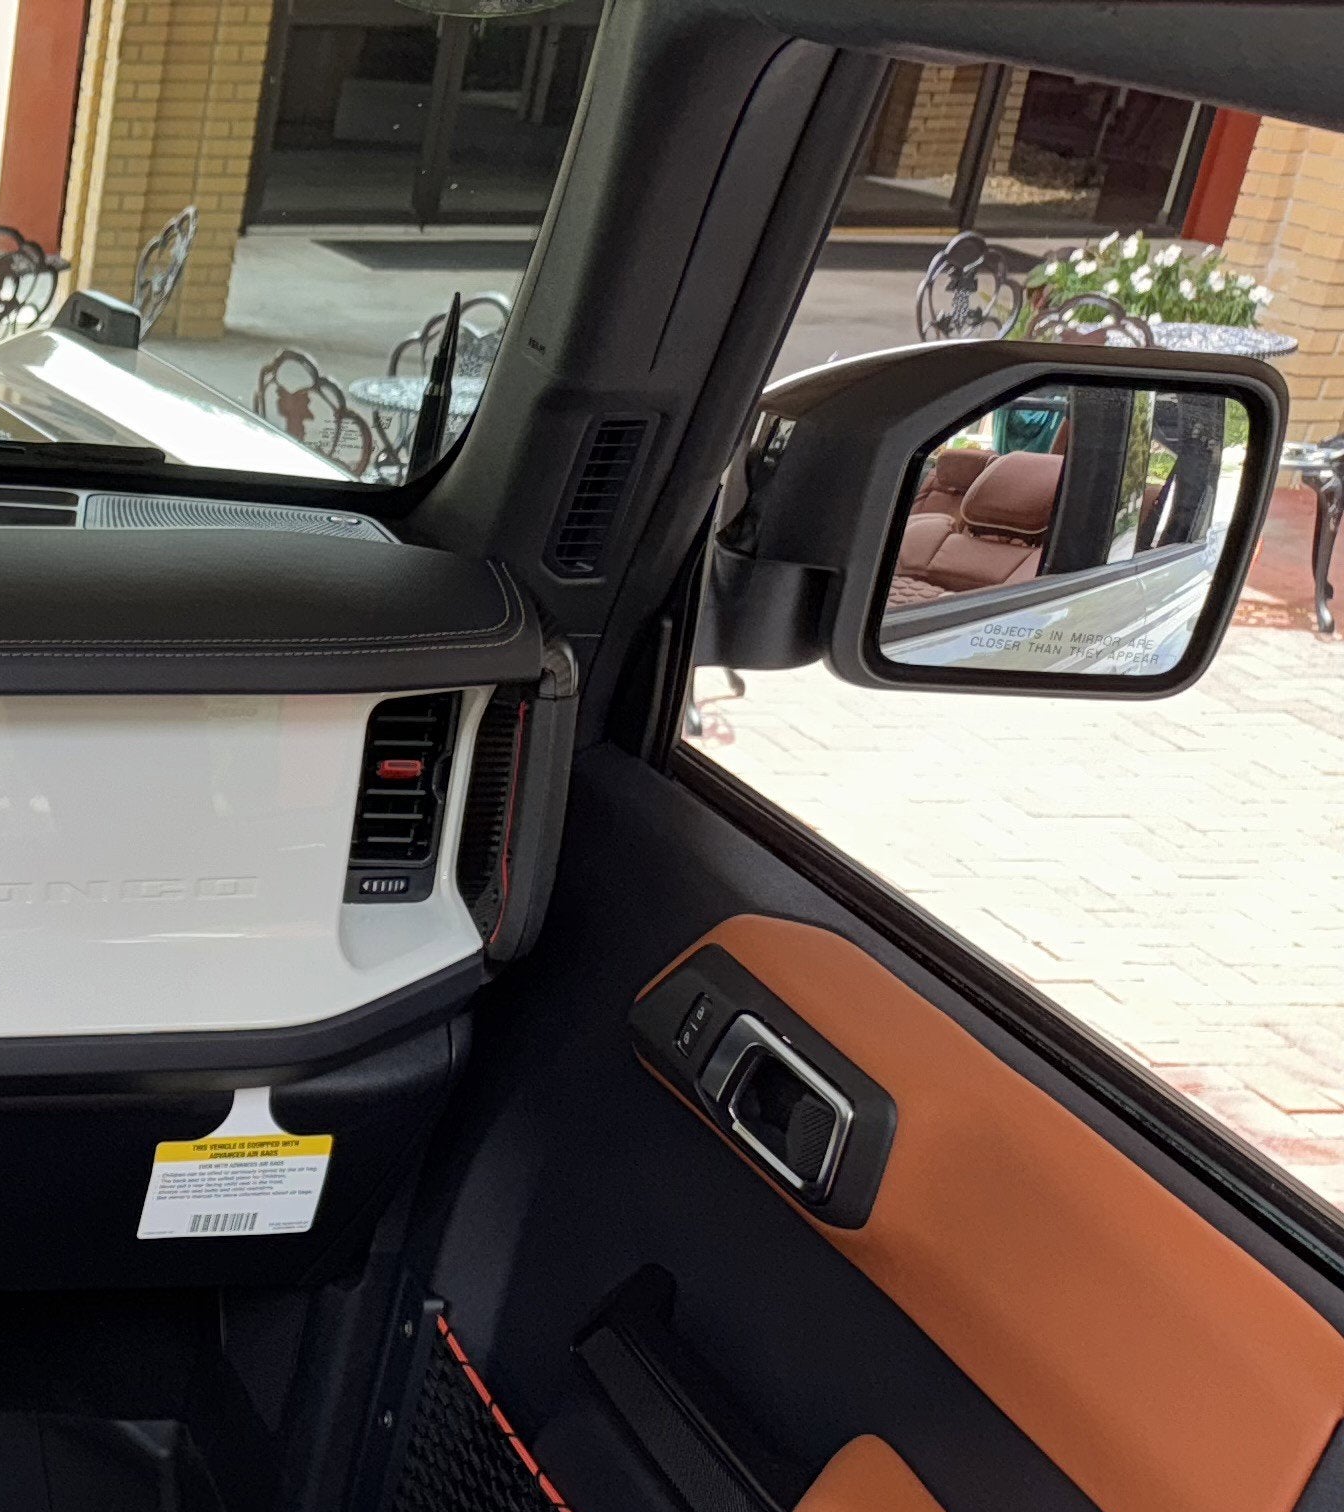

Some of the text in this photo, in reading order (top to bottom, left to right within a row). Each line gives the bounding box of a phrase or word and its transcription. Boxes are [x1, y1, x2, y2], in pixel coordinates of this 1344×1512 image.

[970, 636, 1159, 664] CLOSER THAN THEY APPEAR
[984, 623, 1154, 650] OBJECTS IN MIRROR ARE
